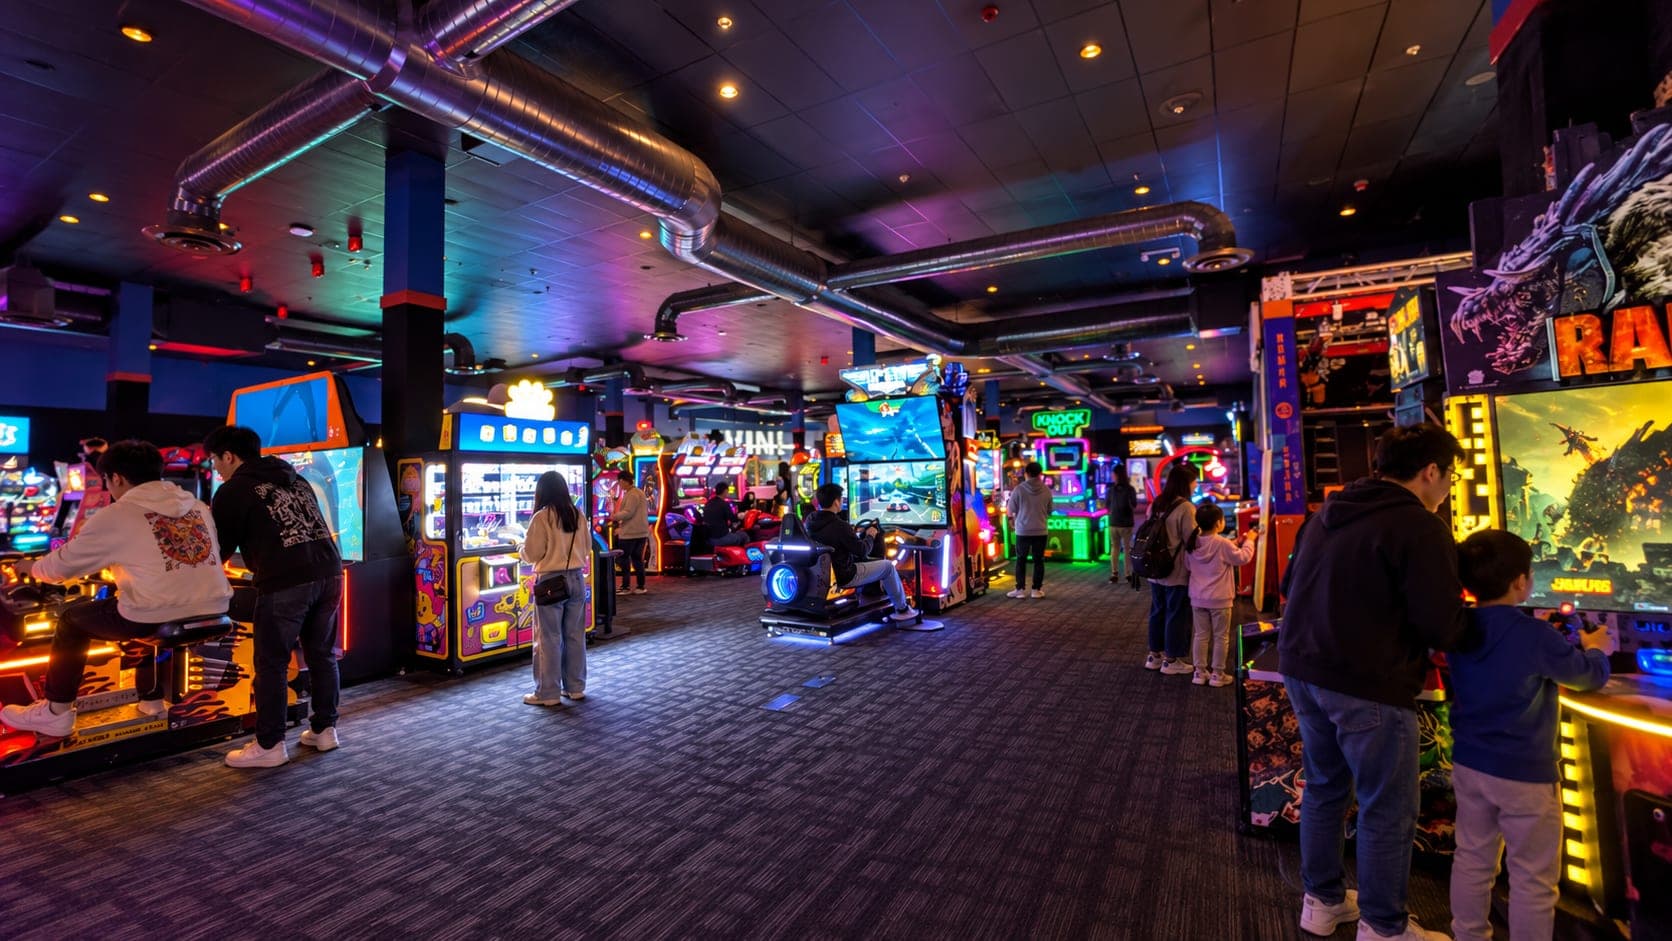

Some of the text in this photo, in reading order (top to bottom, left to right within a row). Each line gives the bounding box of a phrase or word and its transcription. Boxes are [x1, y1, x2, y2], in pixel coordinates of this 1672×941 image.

[1555, 303, 1672, 378] RA
[1037, 412, 1084, 426] KNOCK
[1048, 424, 1075, 436] OUT
